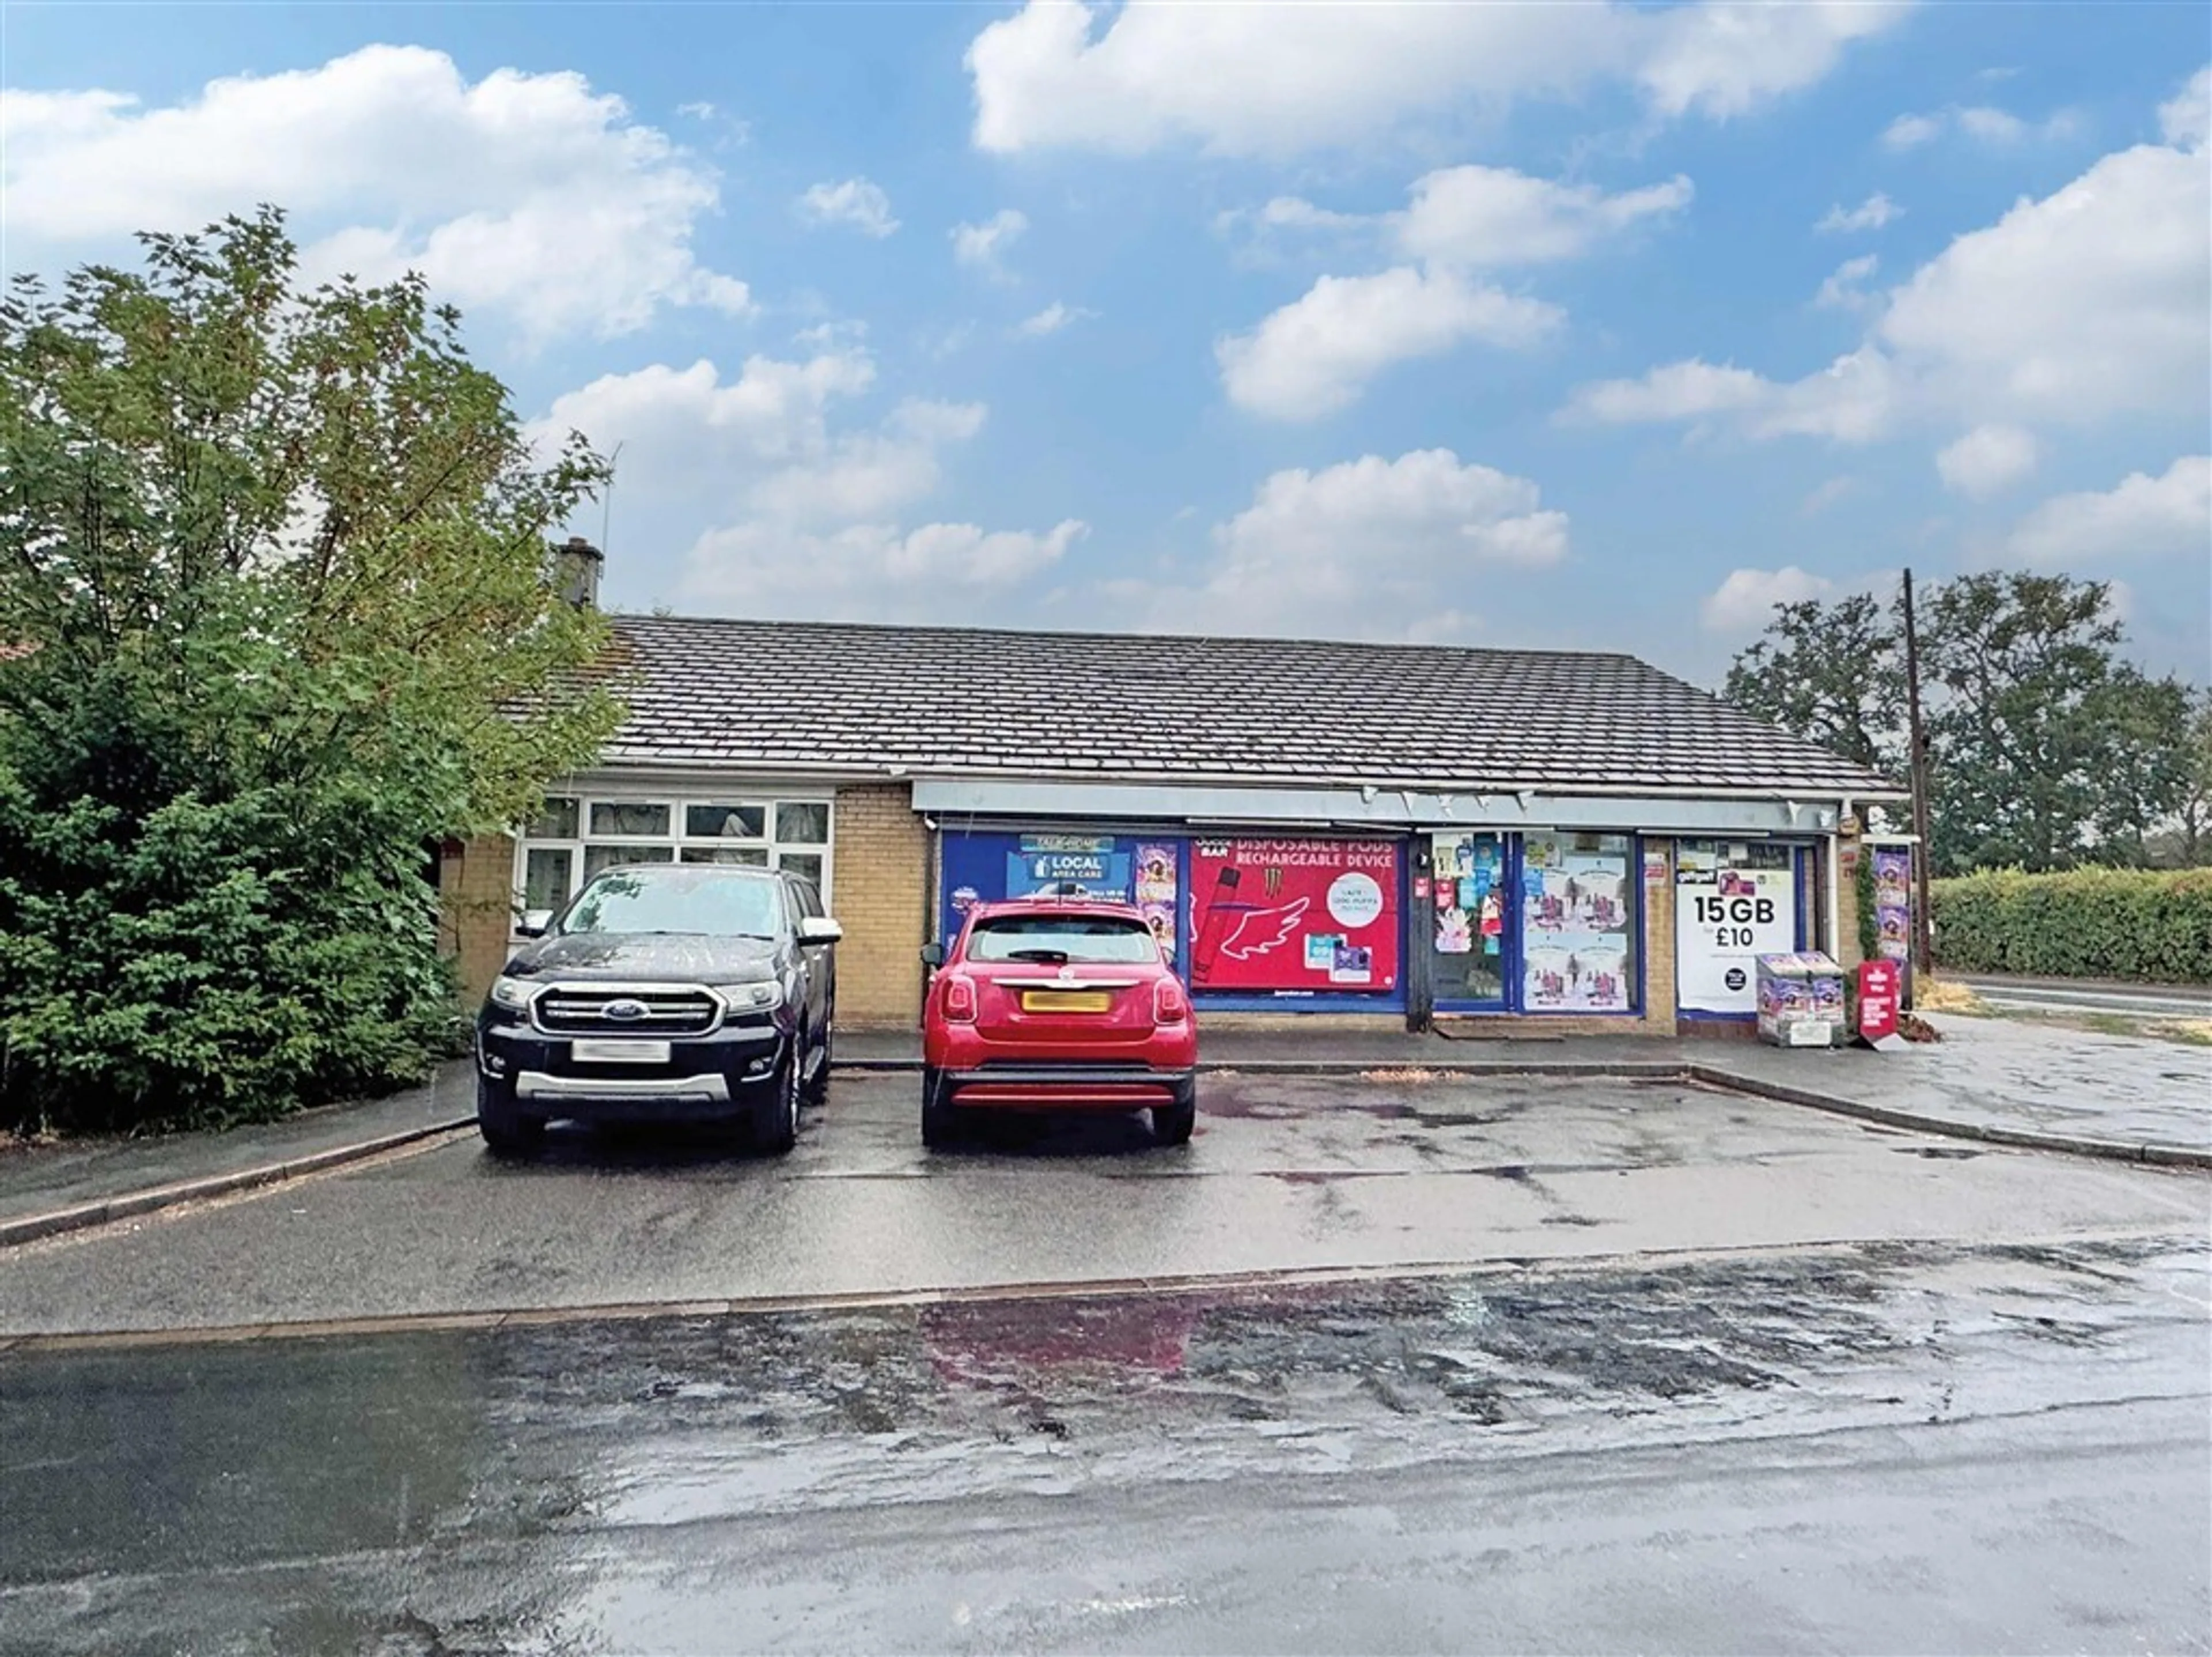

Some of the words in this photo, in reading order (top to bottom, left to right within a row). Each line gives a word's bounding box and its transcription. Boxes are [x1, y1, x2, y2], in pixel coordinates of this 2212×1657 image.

[1237, 839, 1340, 852] DISPOSABLE
[1347, 841, 1392, 853] PODS
[1052, 857, 1102, 869] LOCAL
[1236, 852, 1340, 865] RECHARGEABLE
[1347, 854, 1392, 868] DEVICE
[1716, 926, 1753, 947] £10
